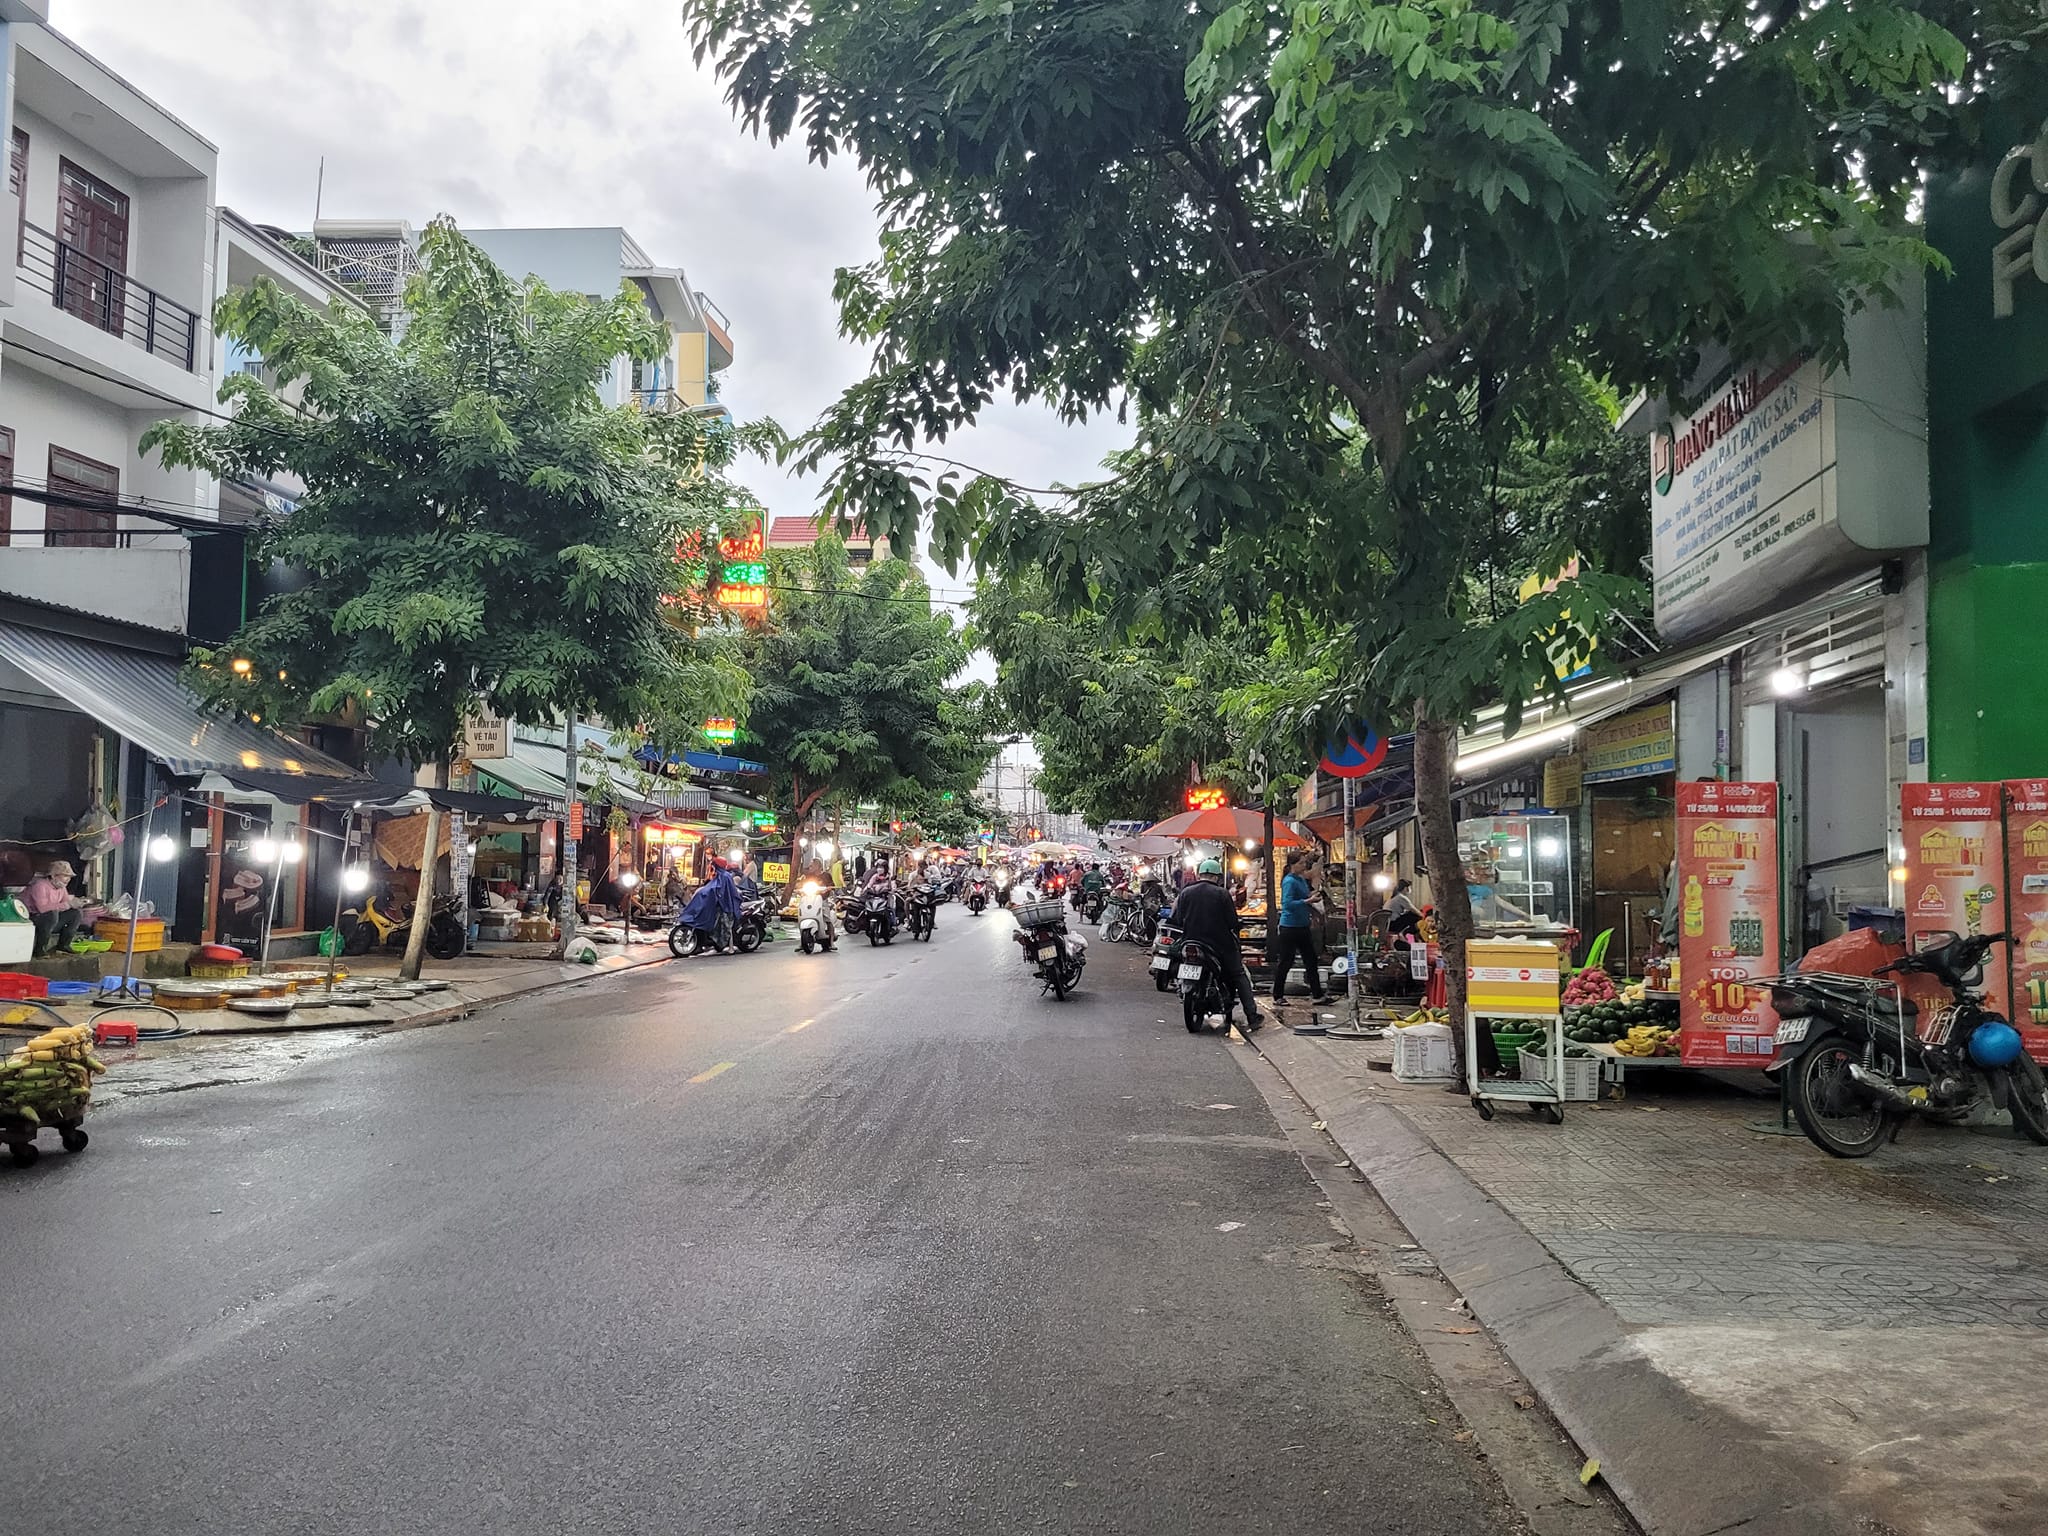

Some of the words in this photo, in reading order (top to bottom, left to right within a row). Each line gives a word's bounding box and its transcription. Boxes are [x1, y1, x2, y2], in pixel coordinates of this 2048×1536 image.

[1740, 406, 1773, 452] ĐỘNG
[1773, 383, 1798, 422] SẢN
[490, 719, 502, 729] BAY
[484, 731, 498, 741] TÀU
[477, 743, 495, 752] TOUR
[1710, 967, 1748, 981] TOP
[1711, 981, 1745, 1010] 10
